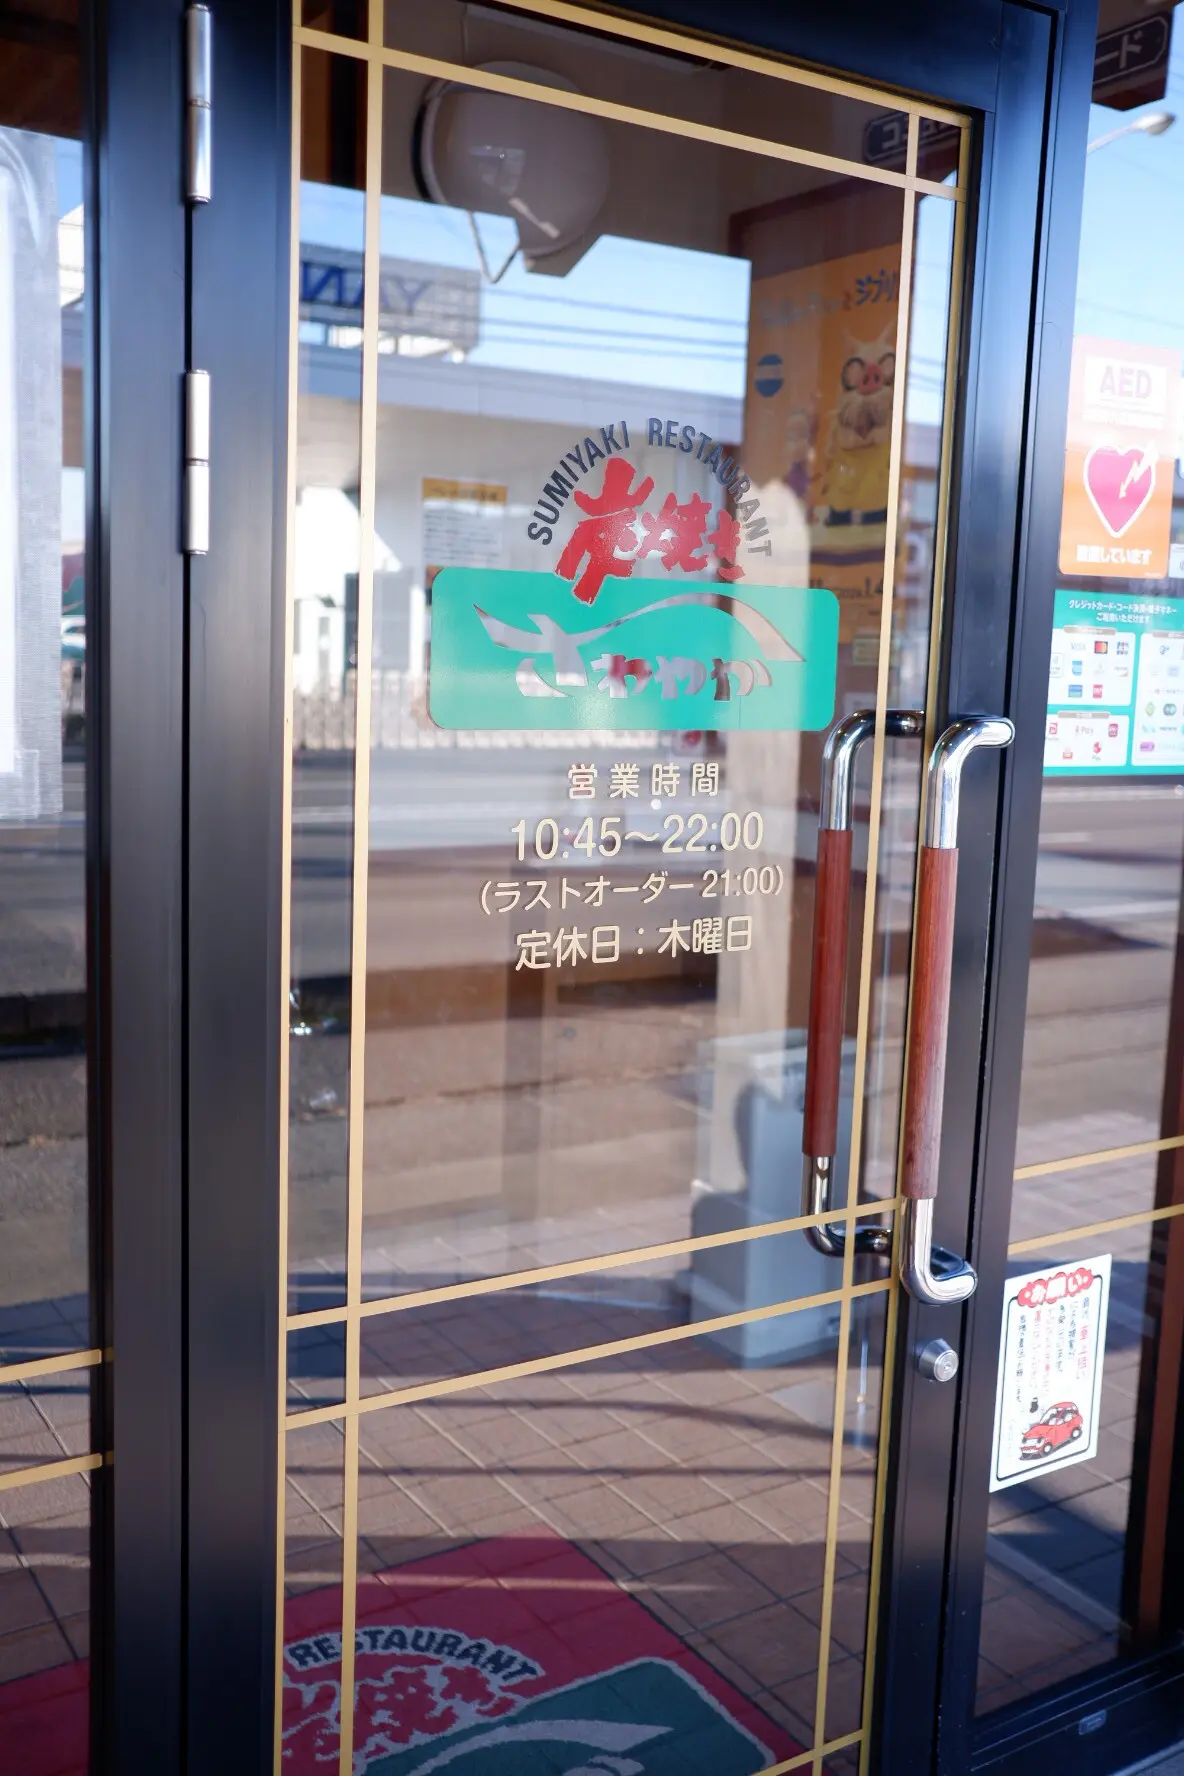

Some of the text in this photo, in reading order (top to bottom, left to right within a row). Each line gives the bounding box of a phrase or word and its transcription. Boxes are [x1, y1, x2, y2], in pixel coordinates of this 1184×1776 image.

[1100, 365, 1152, 399] AED
[527, 420, 631, 546] SUMIYAKI
[648, 417, 772, 557] RESTAURANT
[554, 457, 745, 607] 炭焼き
[473, 592, 806, 702] さわやか
[568, 763, 719, 799] 営業時間
